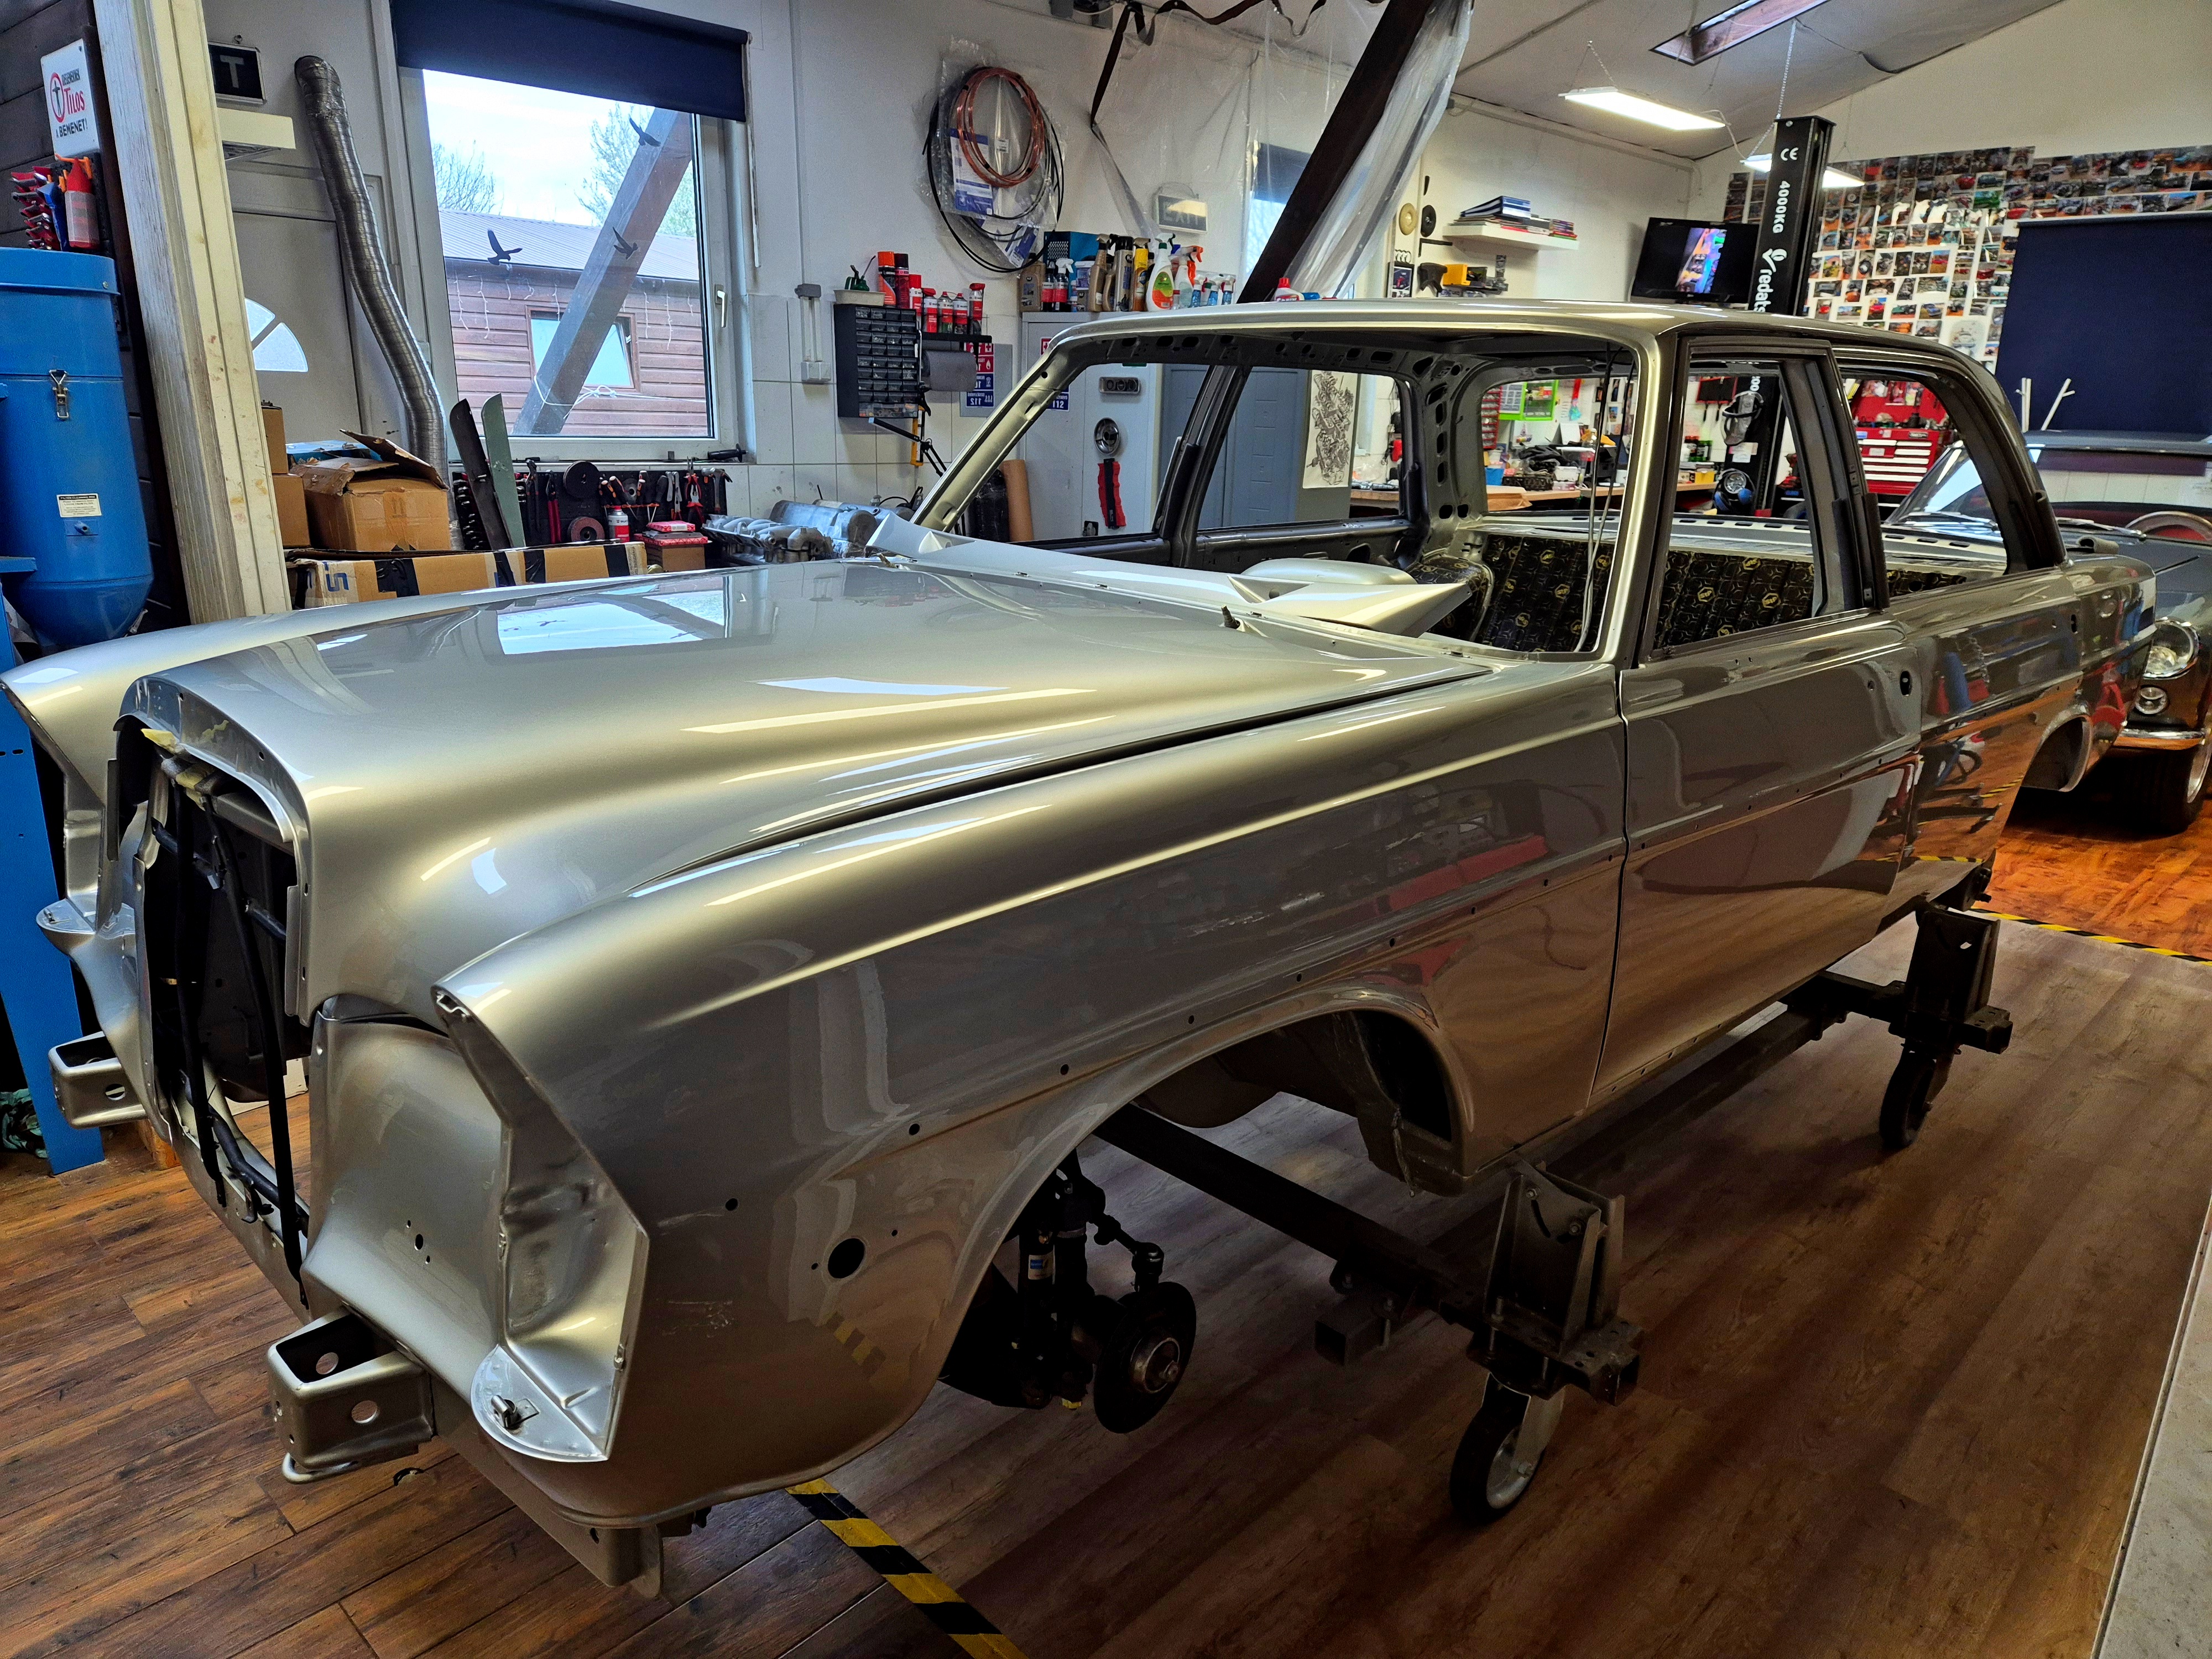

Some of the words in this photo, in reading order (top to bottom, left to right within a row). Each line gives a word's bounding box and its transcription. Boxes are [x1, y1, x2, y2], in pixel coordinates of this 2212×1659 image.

[59, 118, 88, 138] BEMENET!
[1780, 147, 1799, 161] CE
[1772, 180, 1791, 234] 4000KG
[1052, 400, 1065, 409] 112
